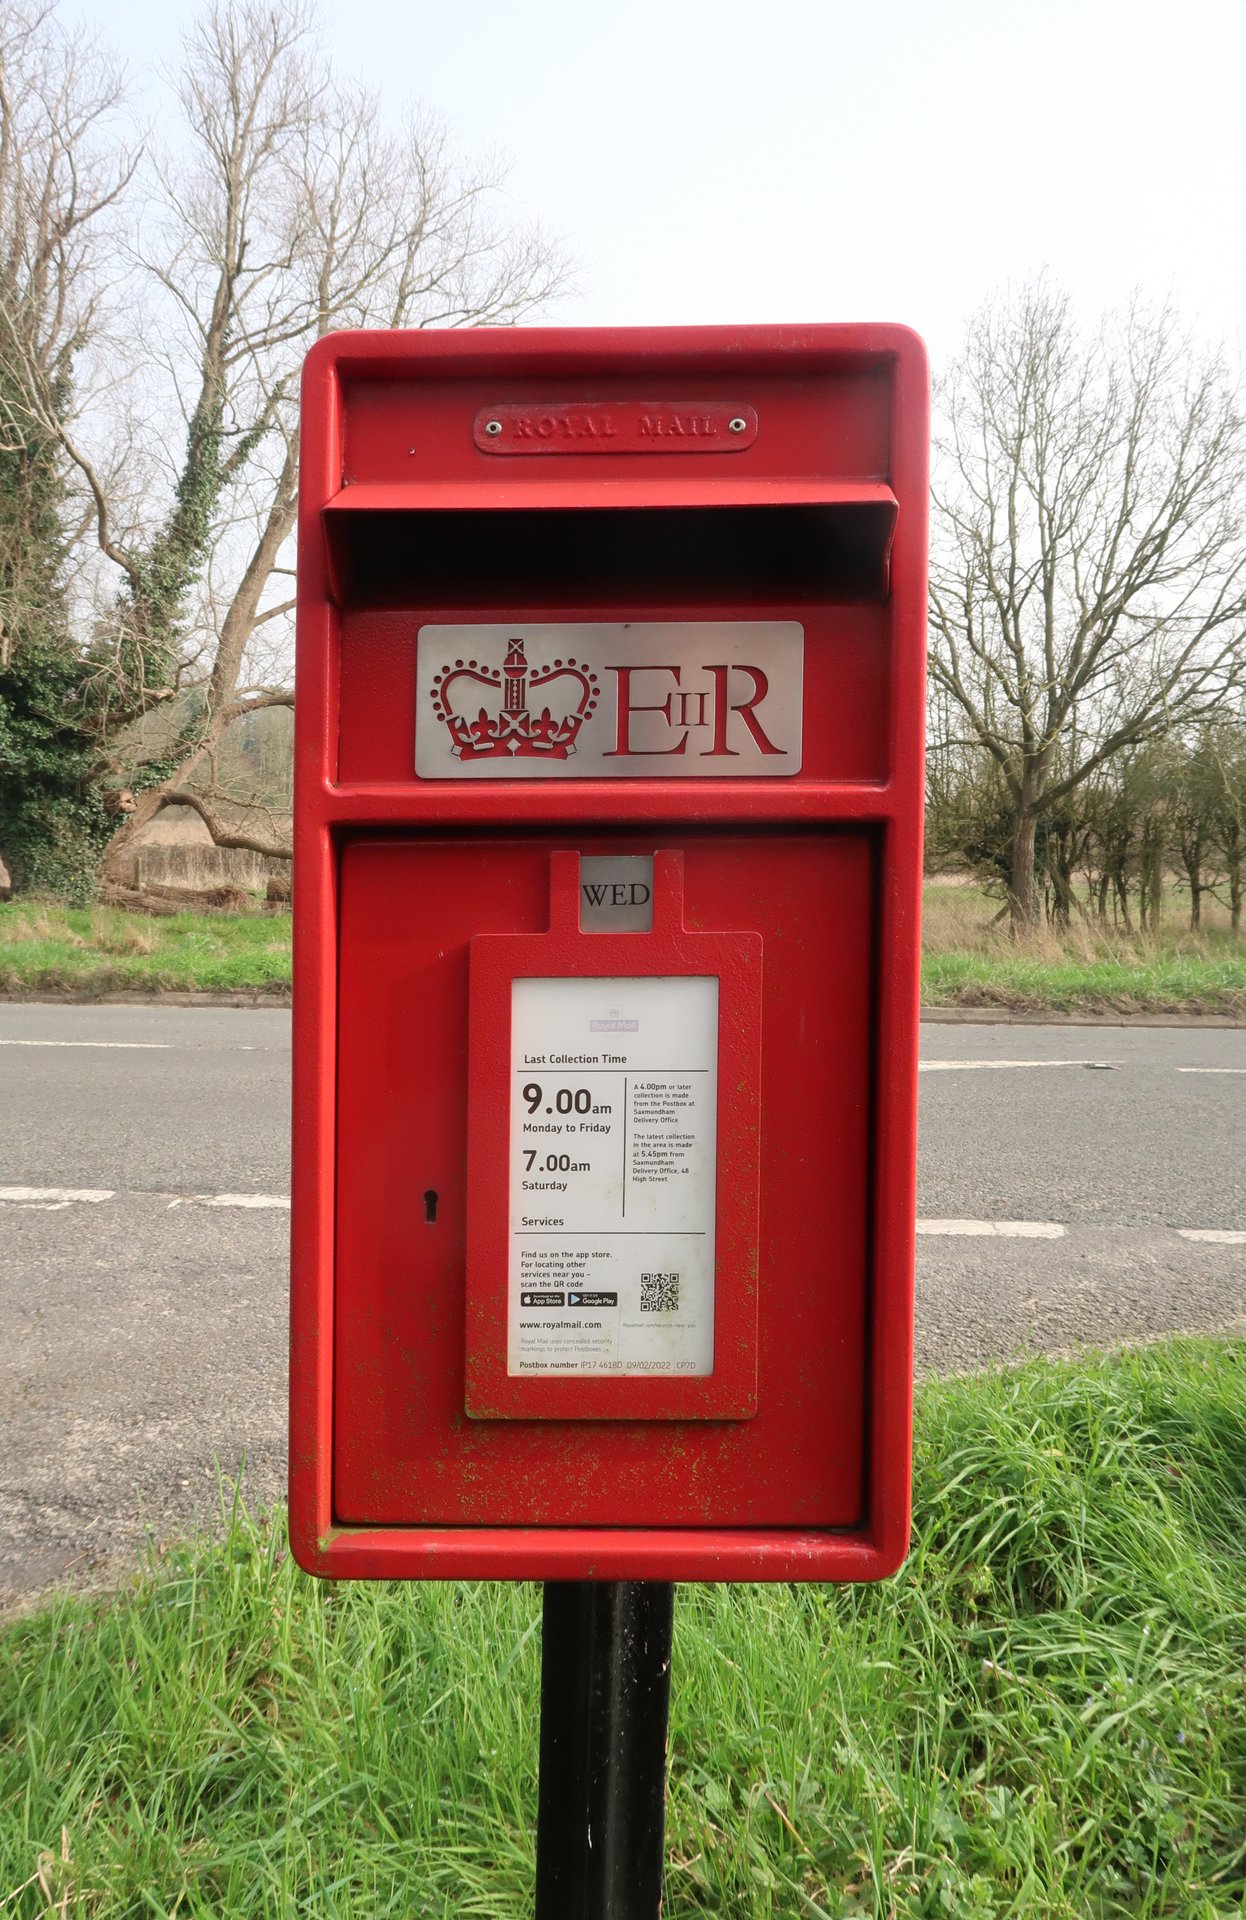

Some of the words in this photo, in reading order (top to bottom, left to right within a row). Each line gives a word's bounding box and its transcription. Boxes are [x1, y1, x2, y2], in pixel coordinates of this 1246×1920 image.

[512, 416, 617, 439] ROYAL
[638, 414, 718, 437] MAIL
[582, 883, 650, 907] WED
[591, 1022, 616, 1031] Royal
[618, 1022, 636, 1030] Mail
[524, 1055, 546, 1063] Last
[550, 1055, 598, 1063] Collection
[602, 1055, 626, 1063] Time
[640, 1083, 666, 1091] 4.00pm
[523, 1083, 612, 1114] 9.00am
[523, 1124, 562, 1133] Monday
[580, 1124, 610, 1133] Friday
[523, 1150, 590, 1171] 7.00am
[522, 1181, 567, 1191] Saturday
[522, 1217, 564, 1226] Services
[535, 1261, 564, 1269] locating
[520, 1321, 601, 1329] www.royalmail.com
